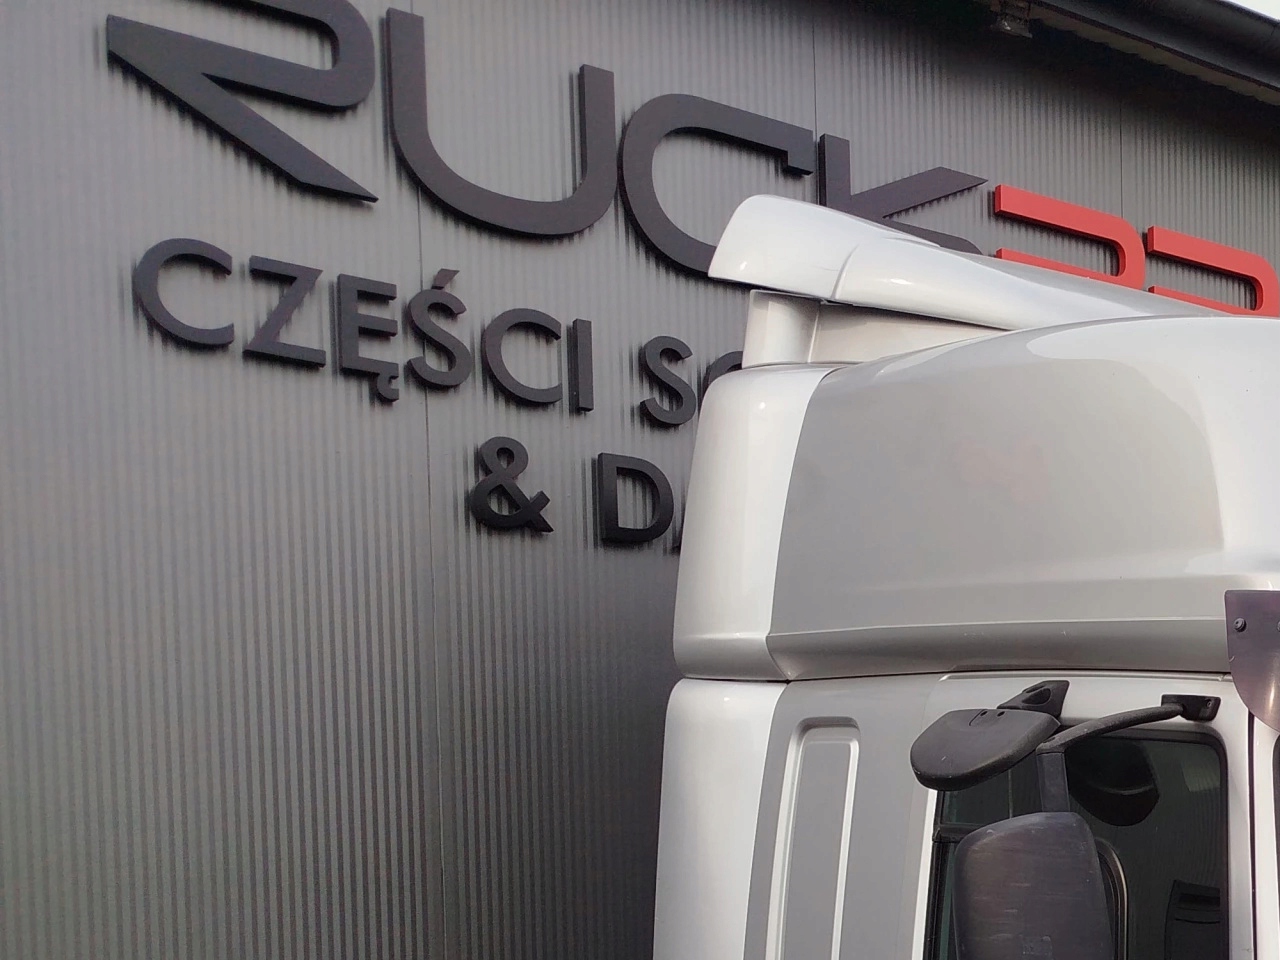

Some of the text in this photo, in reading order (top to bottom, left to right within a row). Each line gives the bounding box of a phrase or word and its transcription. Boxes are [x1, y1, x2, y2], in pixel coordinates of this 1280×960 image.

[132, 237, 744, 426] CZĘŚCI S
[469, 436, 687, 556] & D
